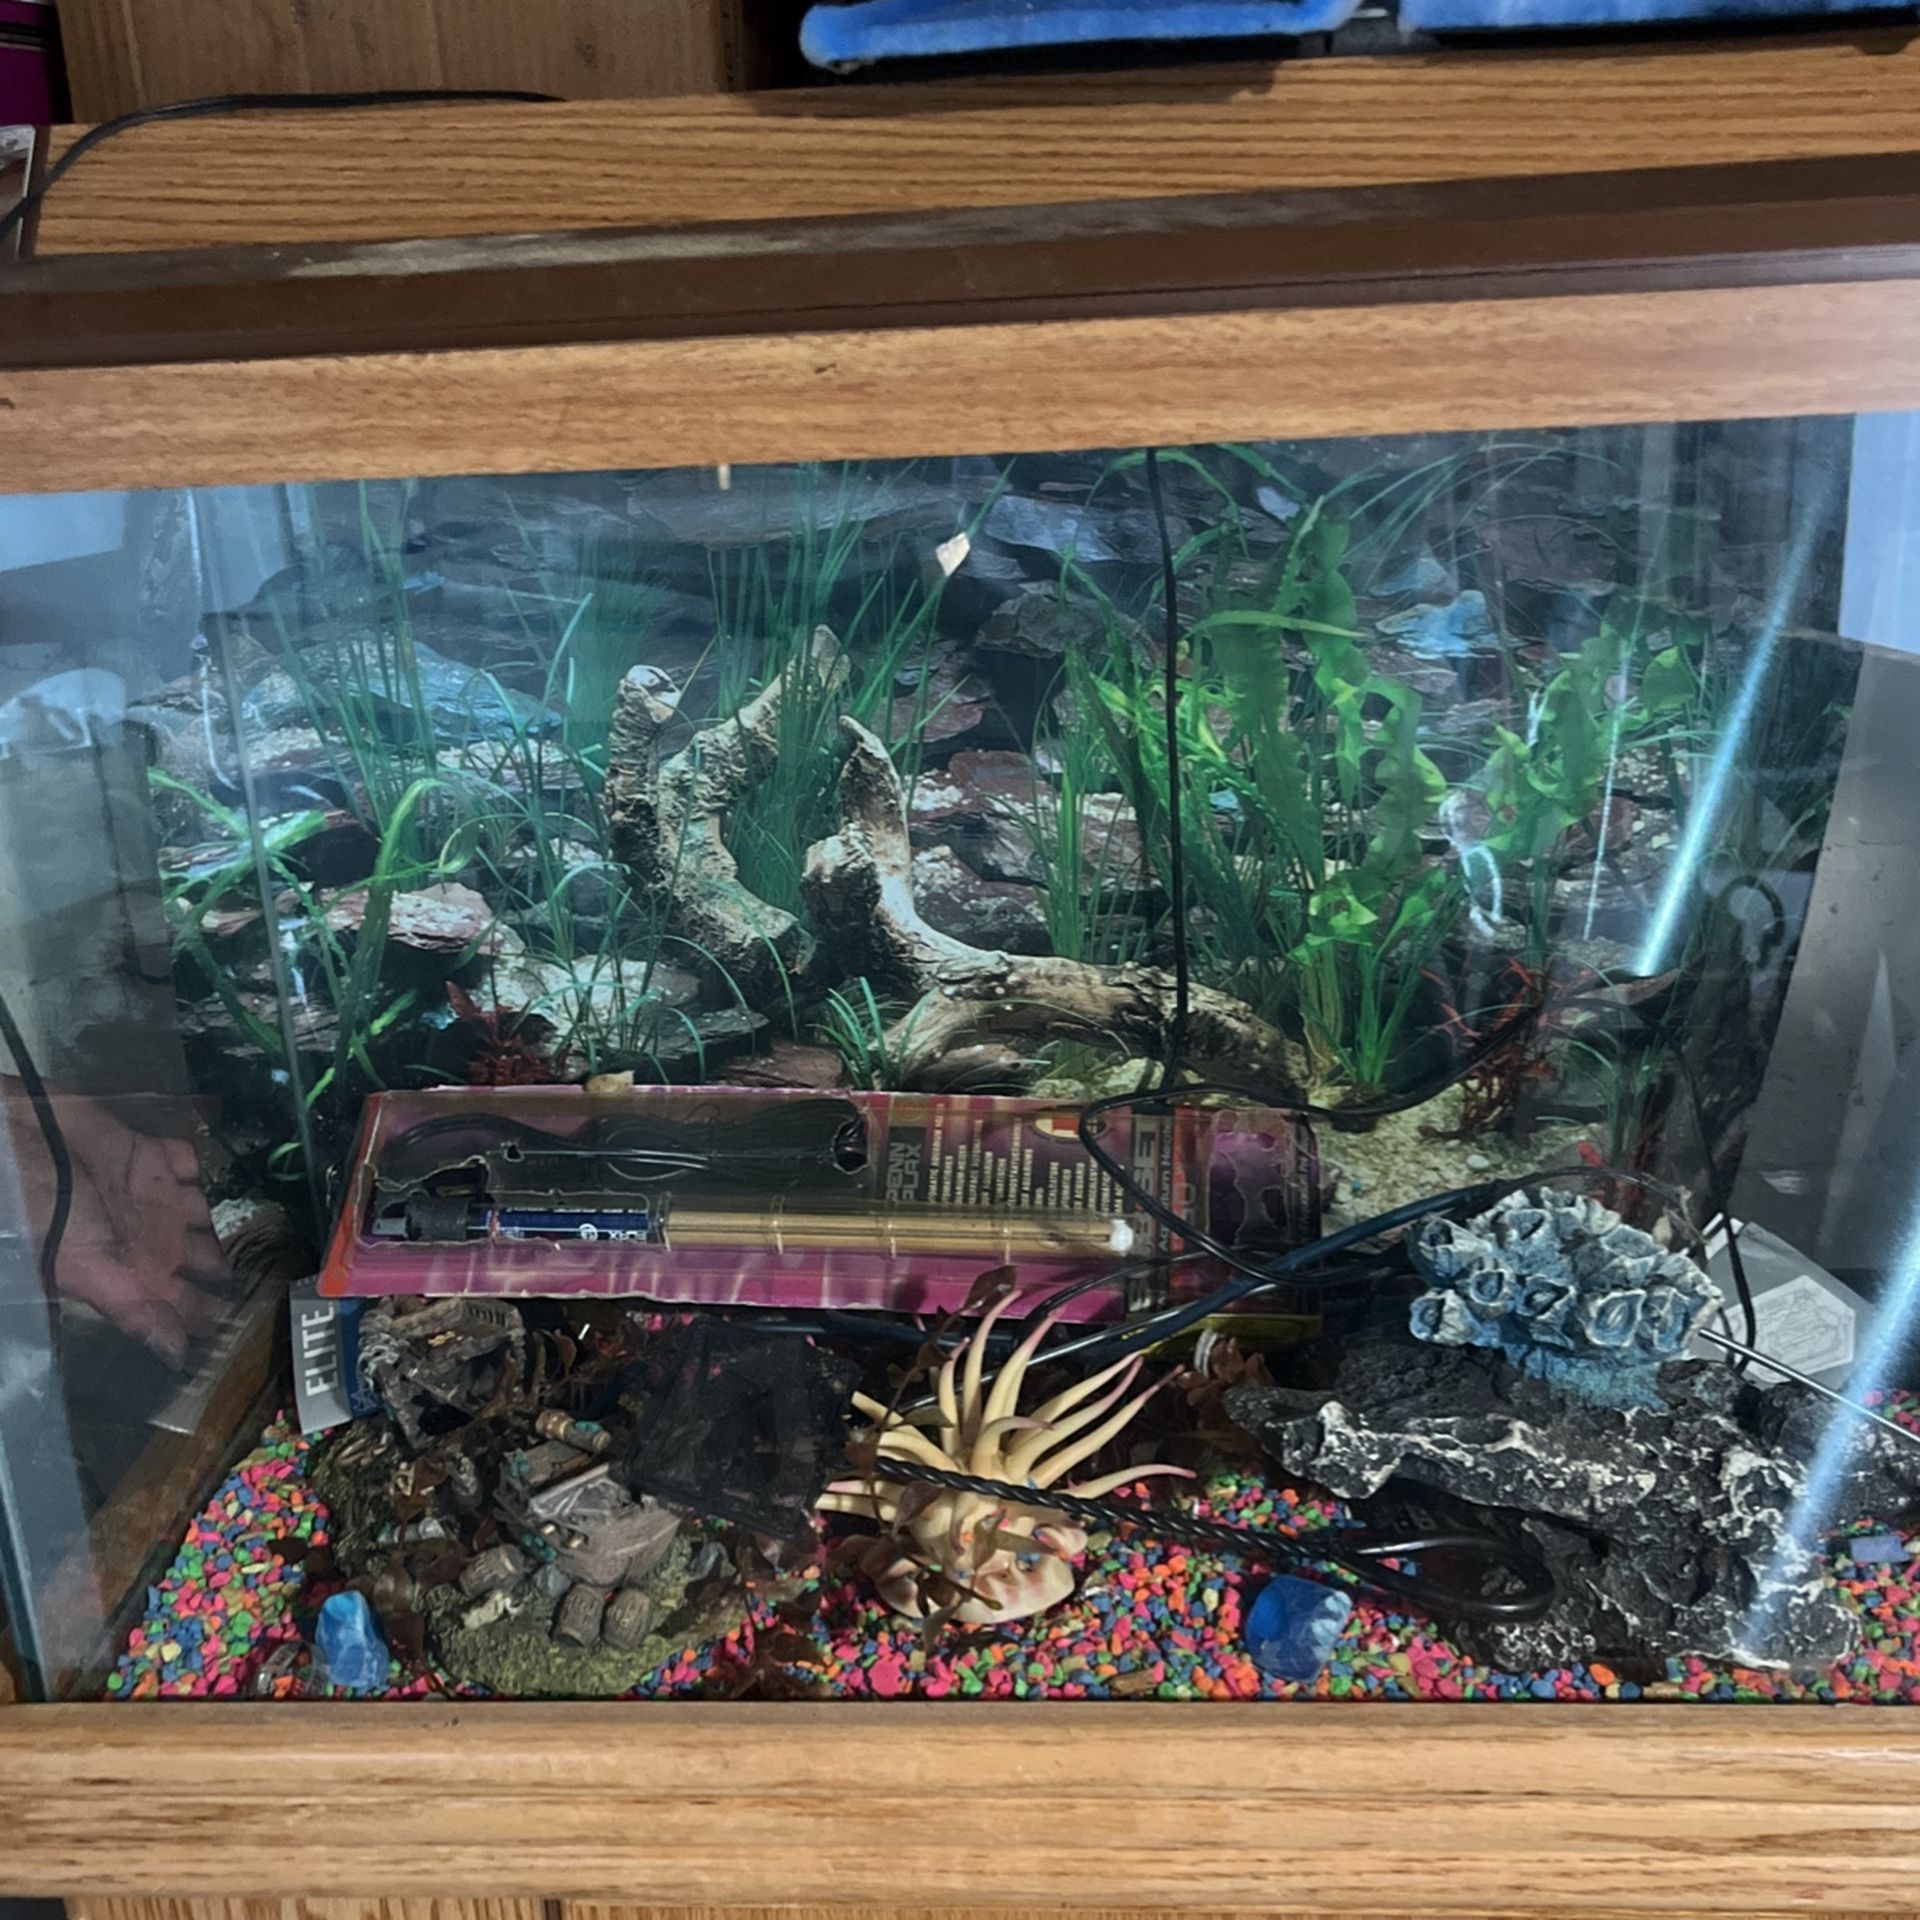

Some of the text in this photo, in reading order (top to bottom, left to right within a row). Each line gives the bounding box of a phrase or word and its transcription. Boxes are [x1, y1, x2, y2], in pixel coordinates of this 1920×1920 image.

[885, 1142, 905, 1202] PENN
[903, 1143, 921, 1200] PLAX
[931, 1129, 942, 1167] AQUARIUM
[1156, 1171, 1171, 1251] Aqrium
[301, 1306, 338, 1397] ELITE
